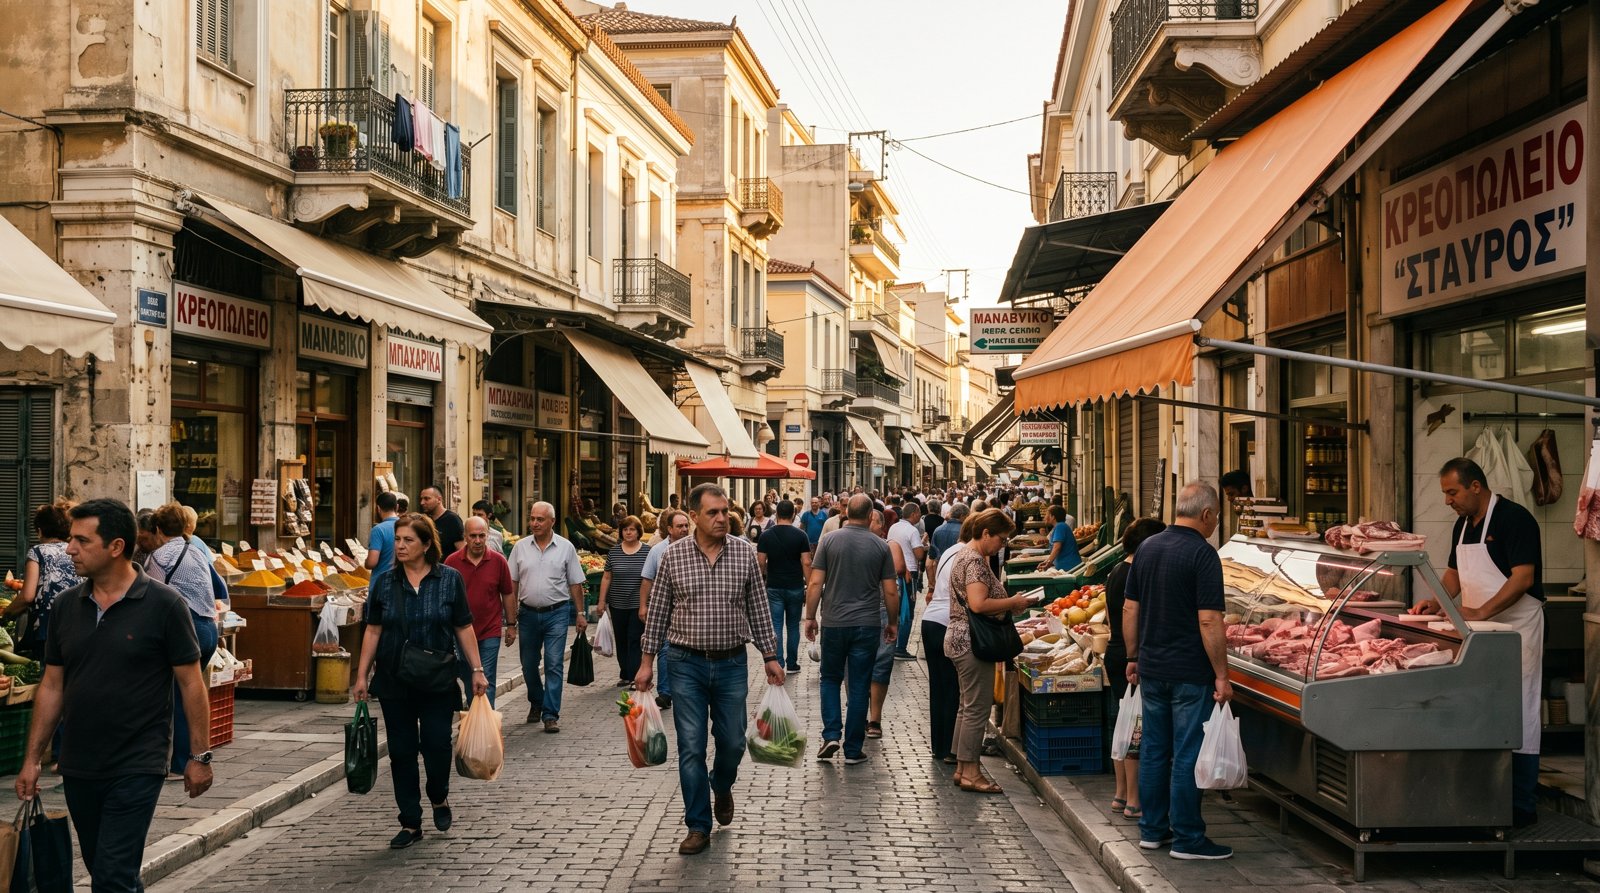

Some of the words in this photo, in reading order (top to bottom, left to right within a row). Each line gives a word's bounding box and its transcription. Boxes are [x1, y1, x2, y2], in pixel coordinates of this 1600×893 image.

[1385, 119, 1584, 249] ΚΡΕΟΠΩΛΕΙΟ
[177, 291, 268, 340] ΚΡΕΟΠΩΛΕΙΟ
[301, 321, 366, 360] ΜΑΝΑΒΙΚΟ
[389, 342, 440, 373] ΜΠΑΧΑΡΙΚΑ
[488, 386, 534, 410] ΜΠΑΧΑΡΙΚΑ
